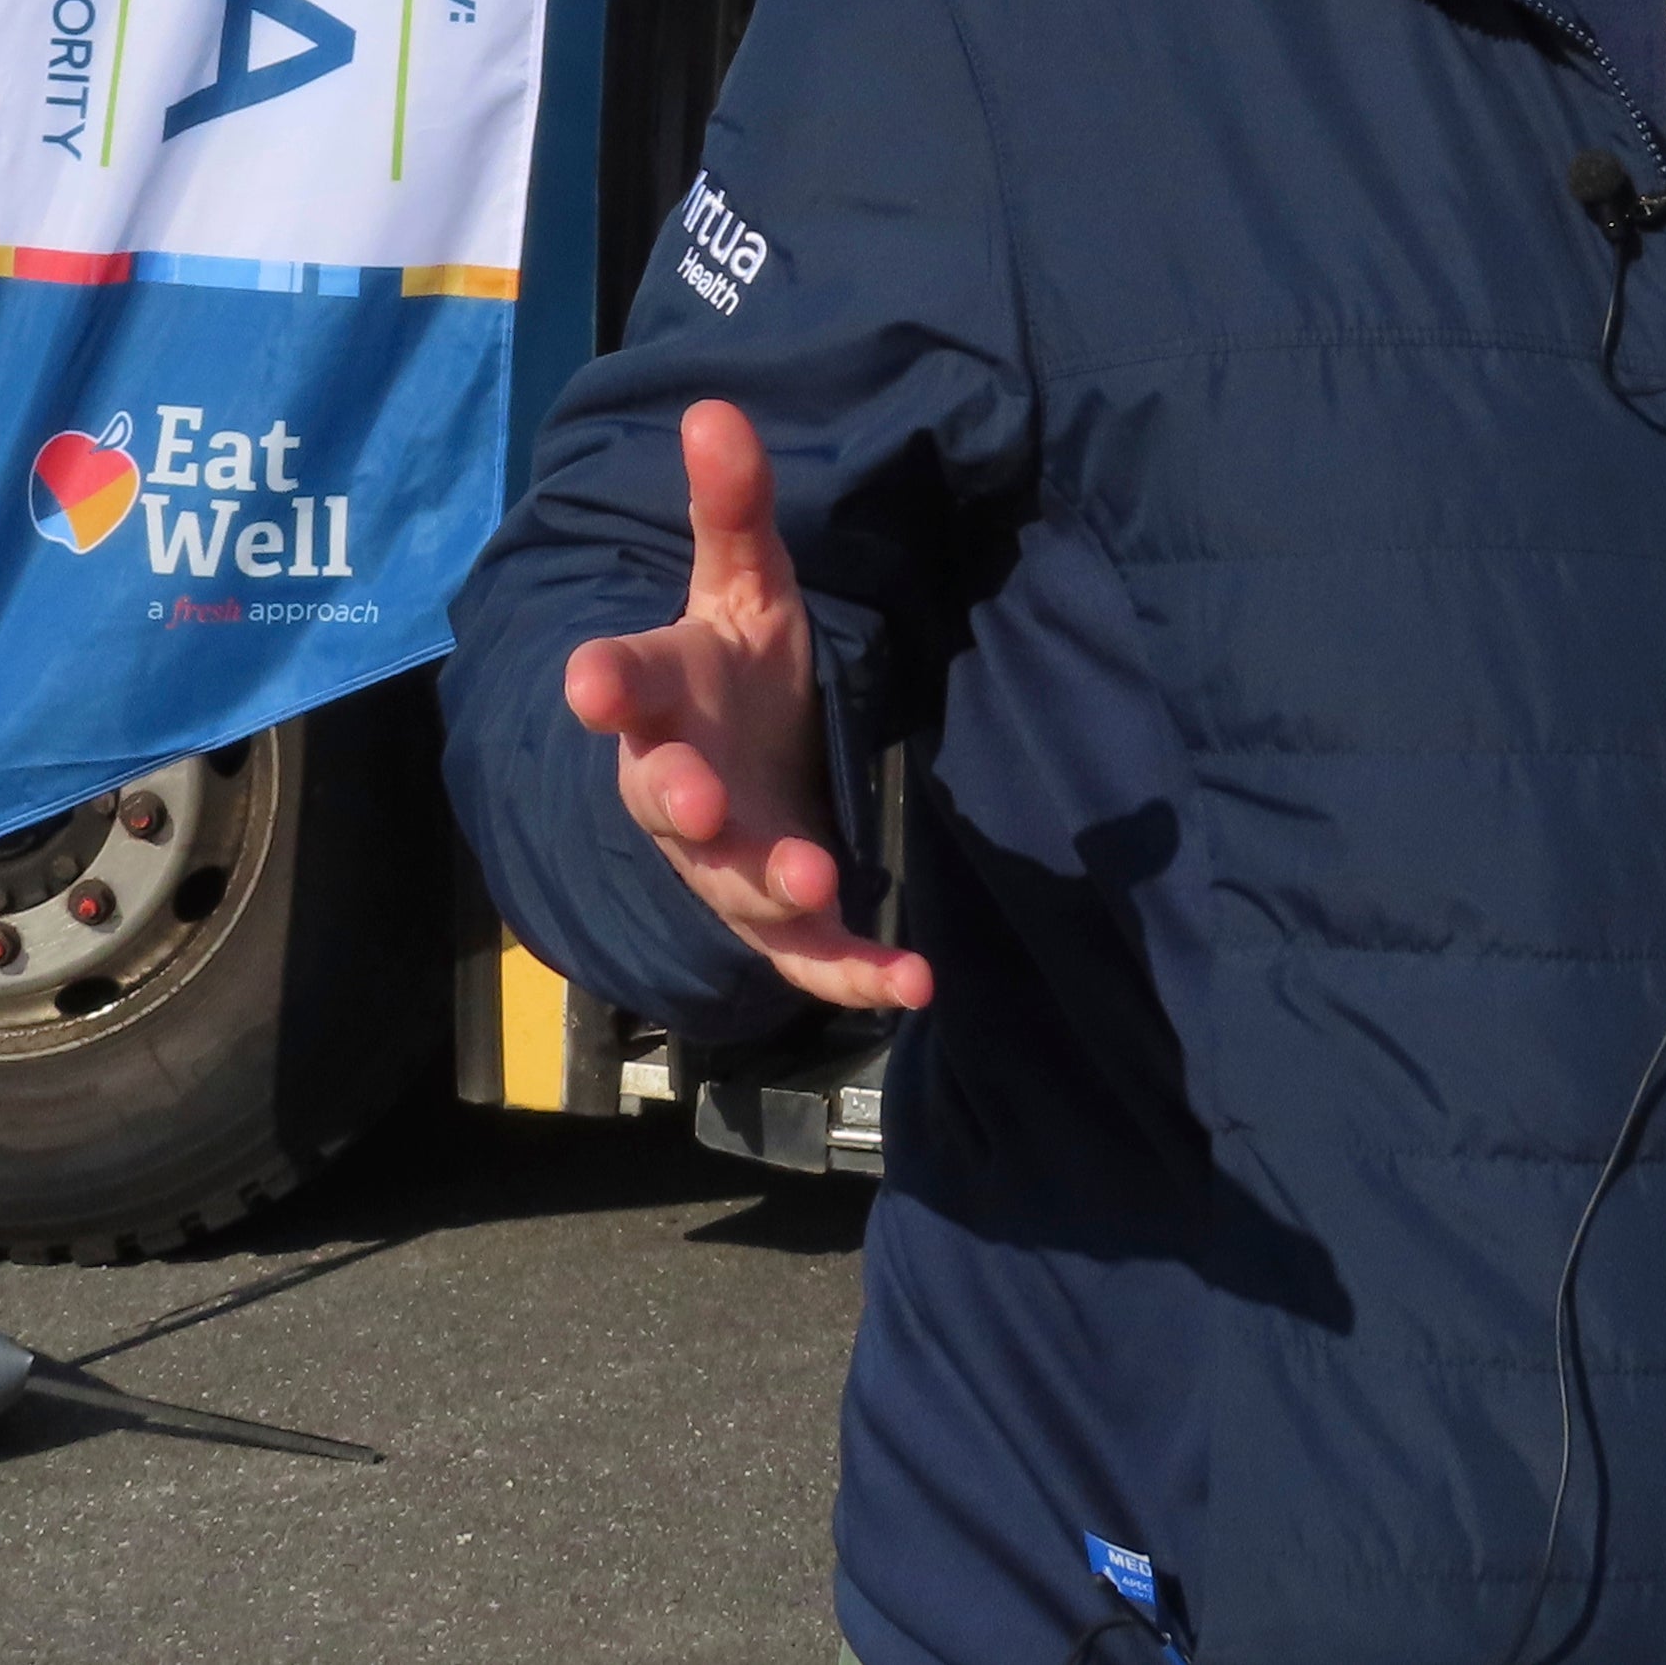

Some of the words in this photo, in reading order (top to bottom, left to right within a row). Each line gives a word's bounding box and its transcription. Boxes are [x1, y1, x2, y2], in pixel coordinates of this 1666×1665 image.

[677, 245, 740, 316] Health
[146, 404, 301, 493] Eat
[140, 492, 353, 578] Well
[147, 600, 164, 620] a
[165, 593, 242, 629] fresh
[247, 599, 379, 625] approach
